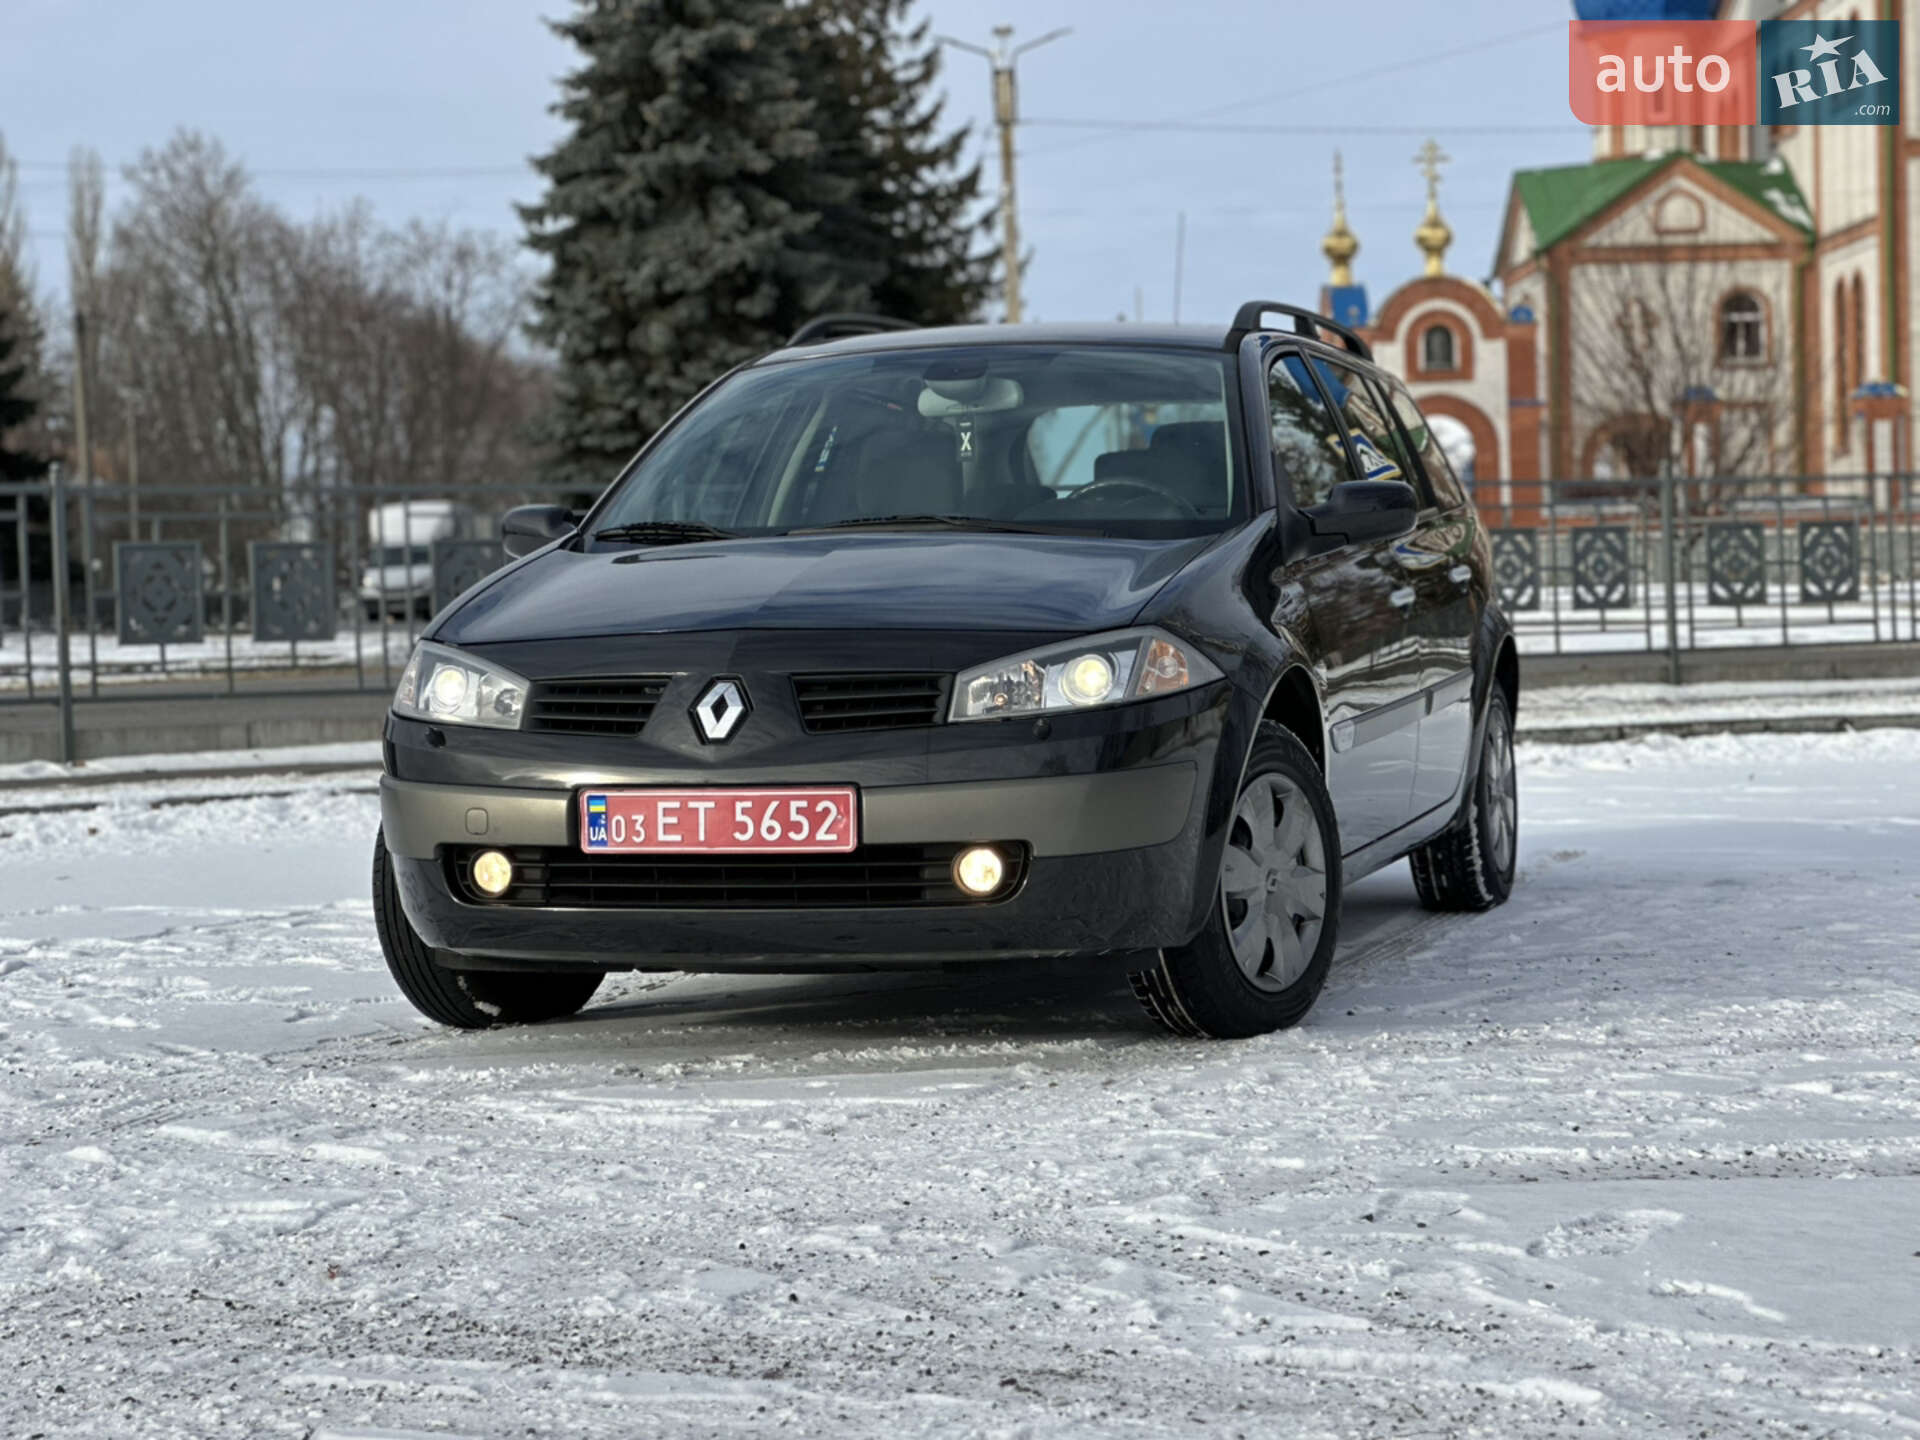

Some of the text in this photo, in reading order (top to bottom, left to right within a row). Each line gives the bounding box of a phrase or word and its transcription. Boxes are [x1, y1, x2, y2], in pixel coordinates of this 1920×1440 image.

[589, 826, 607, 841] UA
[611, 800, 838, 843] 03 ET 5652
